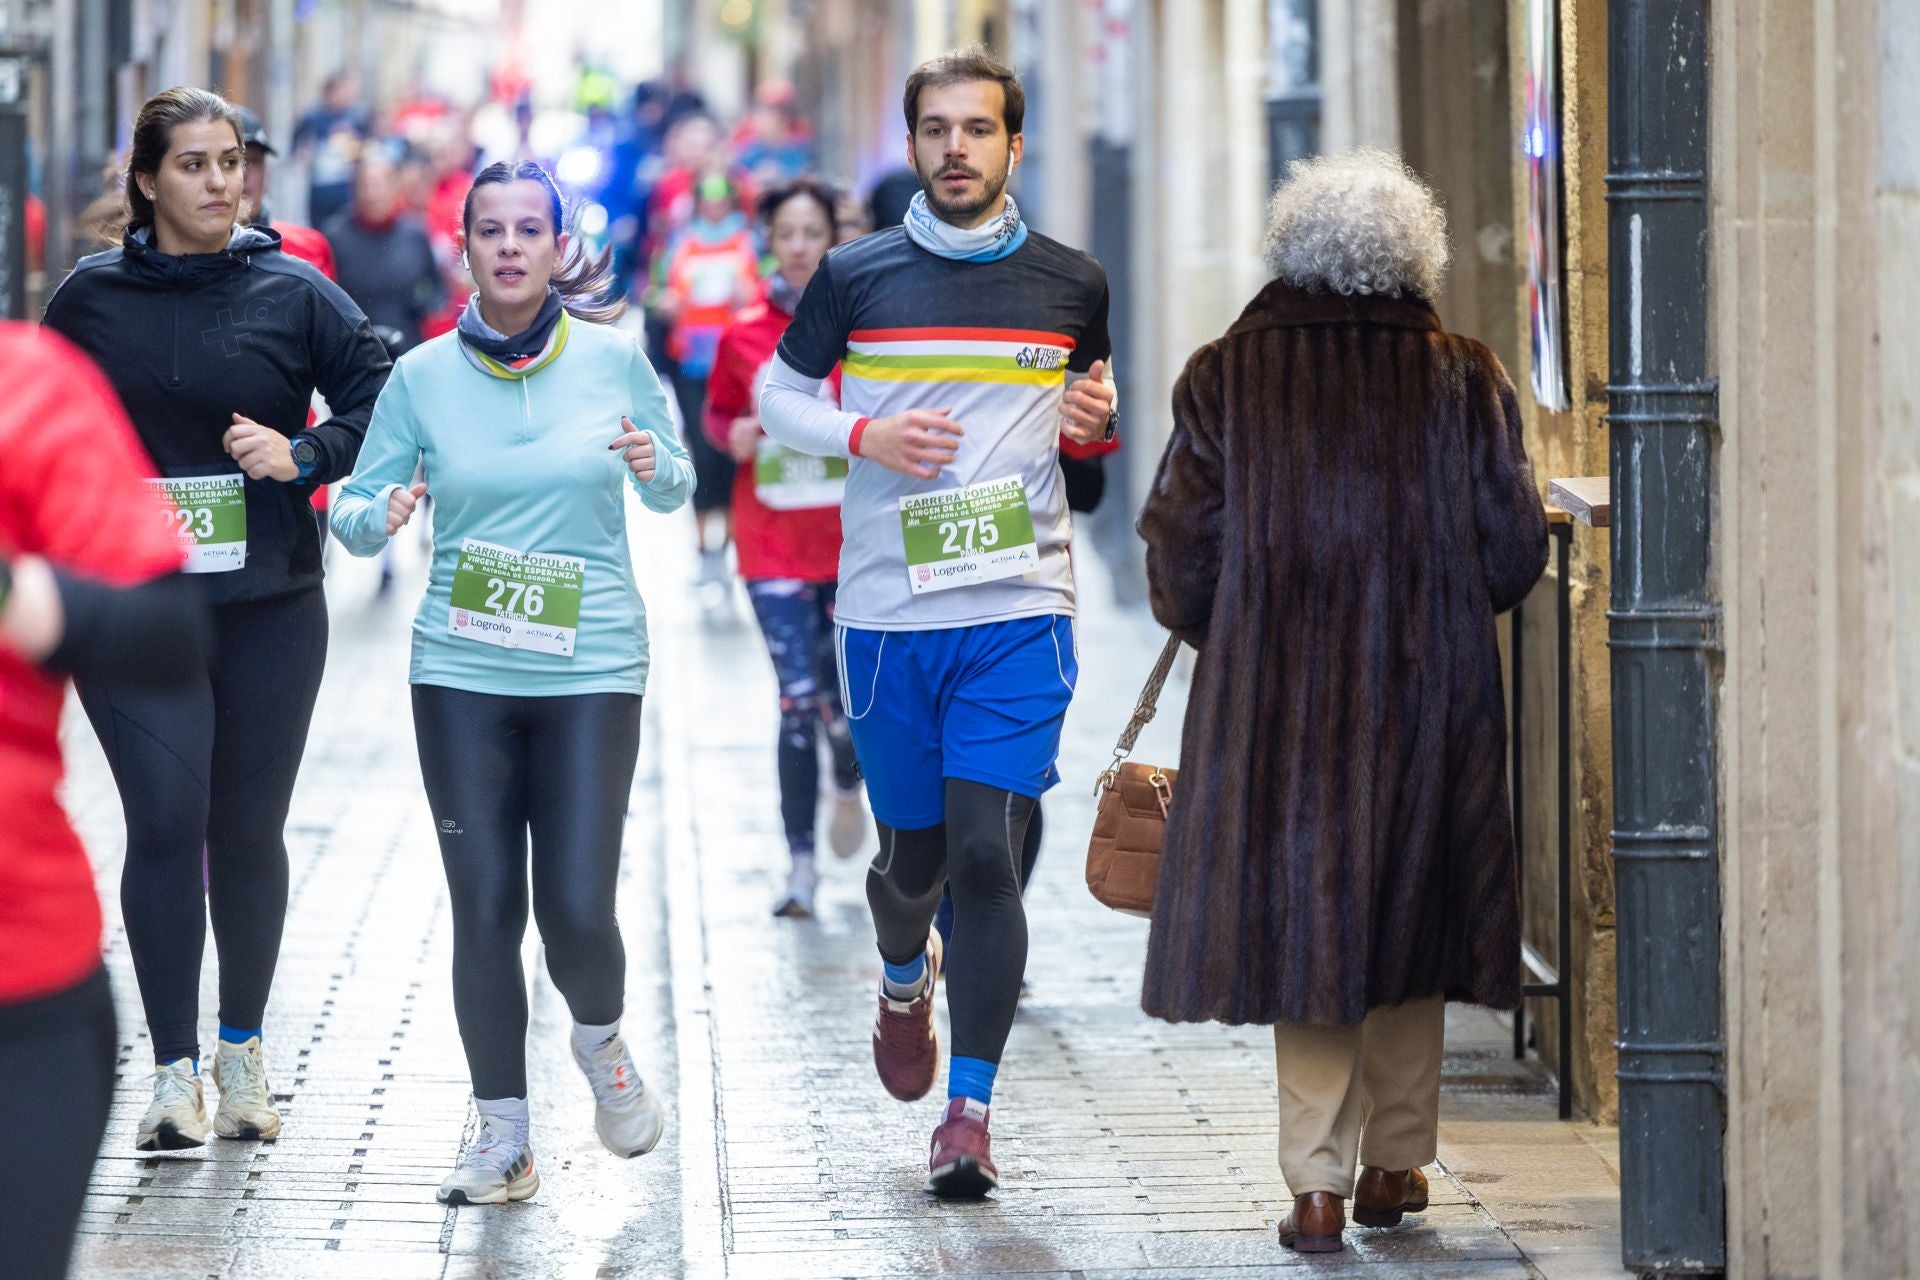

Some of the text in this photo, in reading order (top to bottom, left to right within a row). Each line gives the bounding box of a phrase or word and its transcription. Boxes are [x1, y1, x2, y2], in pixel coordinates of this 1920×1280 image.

[185, 479, 240, 490] POPULAR
[190, 490, 238, 499] ESPERANZA
[904, 480, 1019, 508] CARRERA POPULAR
[909, 507, 940, 518] VIRGEN
[956, 502, 968, 510] LA
[970, 491, 1019, 508] ESPERANZA
[929, 512, 958, 521] PATRONA
[972, 502, 1002, 514] LOGROÑO
[938, 514, 999, 554] 275
[466, 544, 580, 571] CARRERA POPULAR
[991, 555, 1016, 564] ACTUAL
[468, 554, 576, 580] VIRGEN DE LA ESPERANZA
[482, 567, 510, 578] PATRONA
[524, 574, 556, 584] LOGROÑO
[933, 563, 977, 577] Logroño
[485, 578, 544, 616] 276
[496, 610, 528, 622] PATRICIA
[471, 617, 512, 634] Logroño
